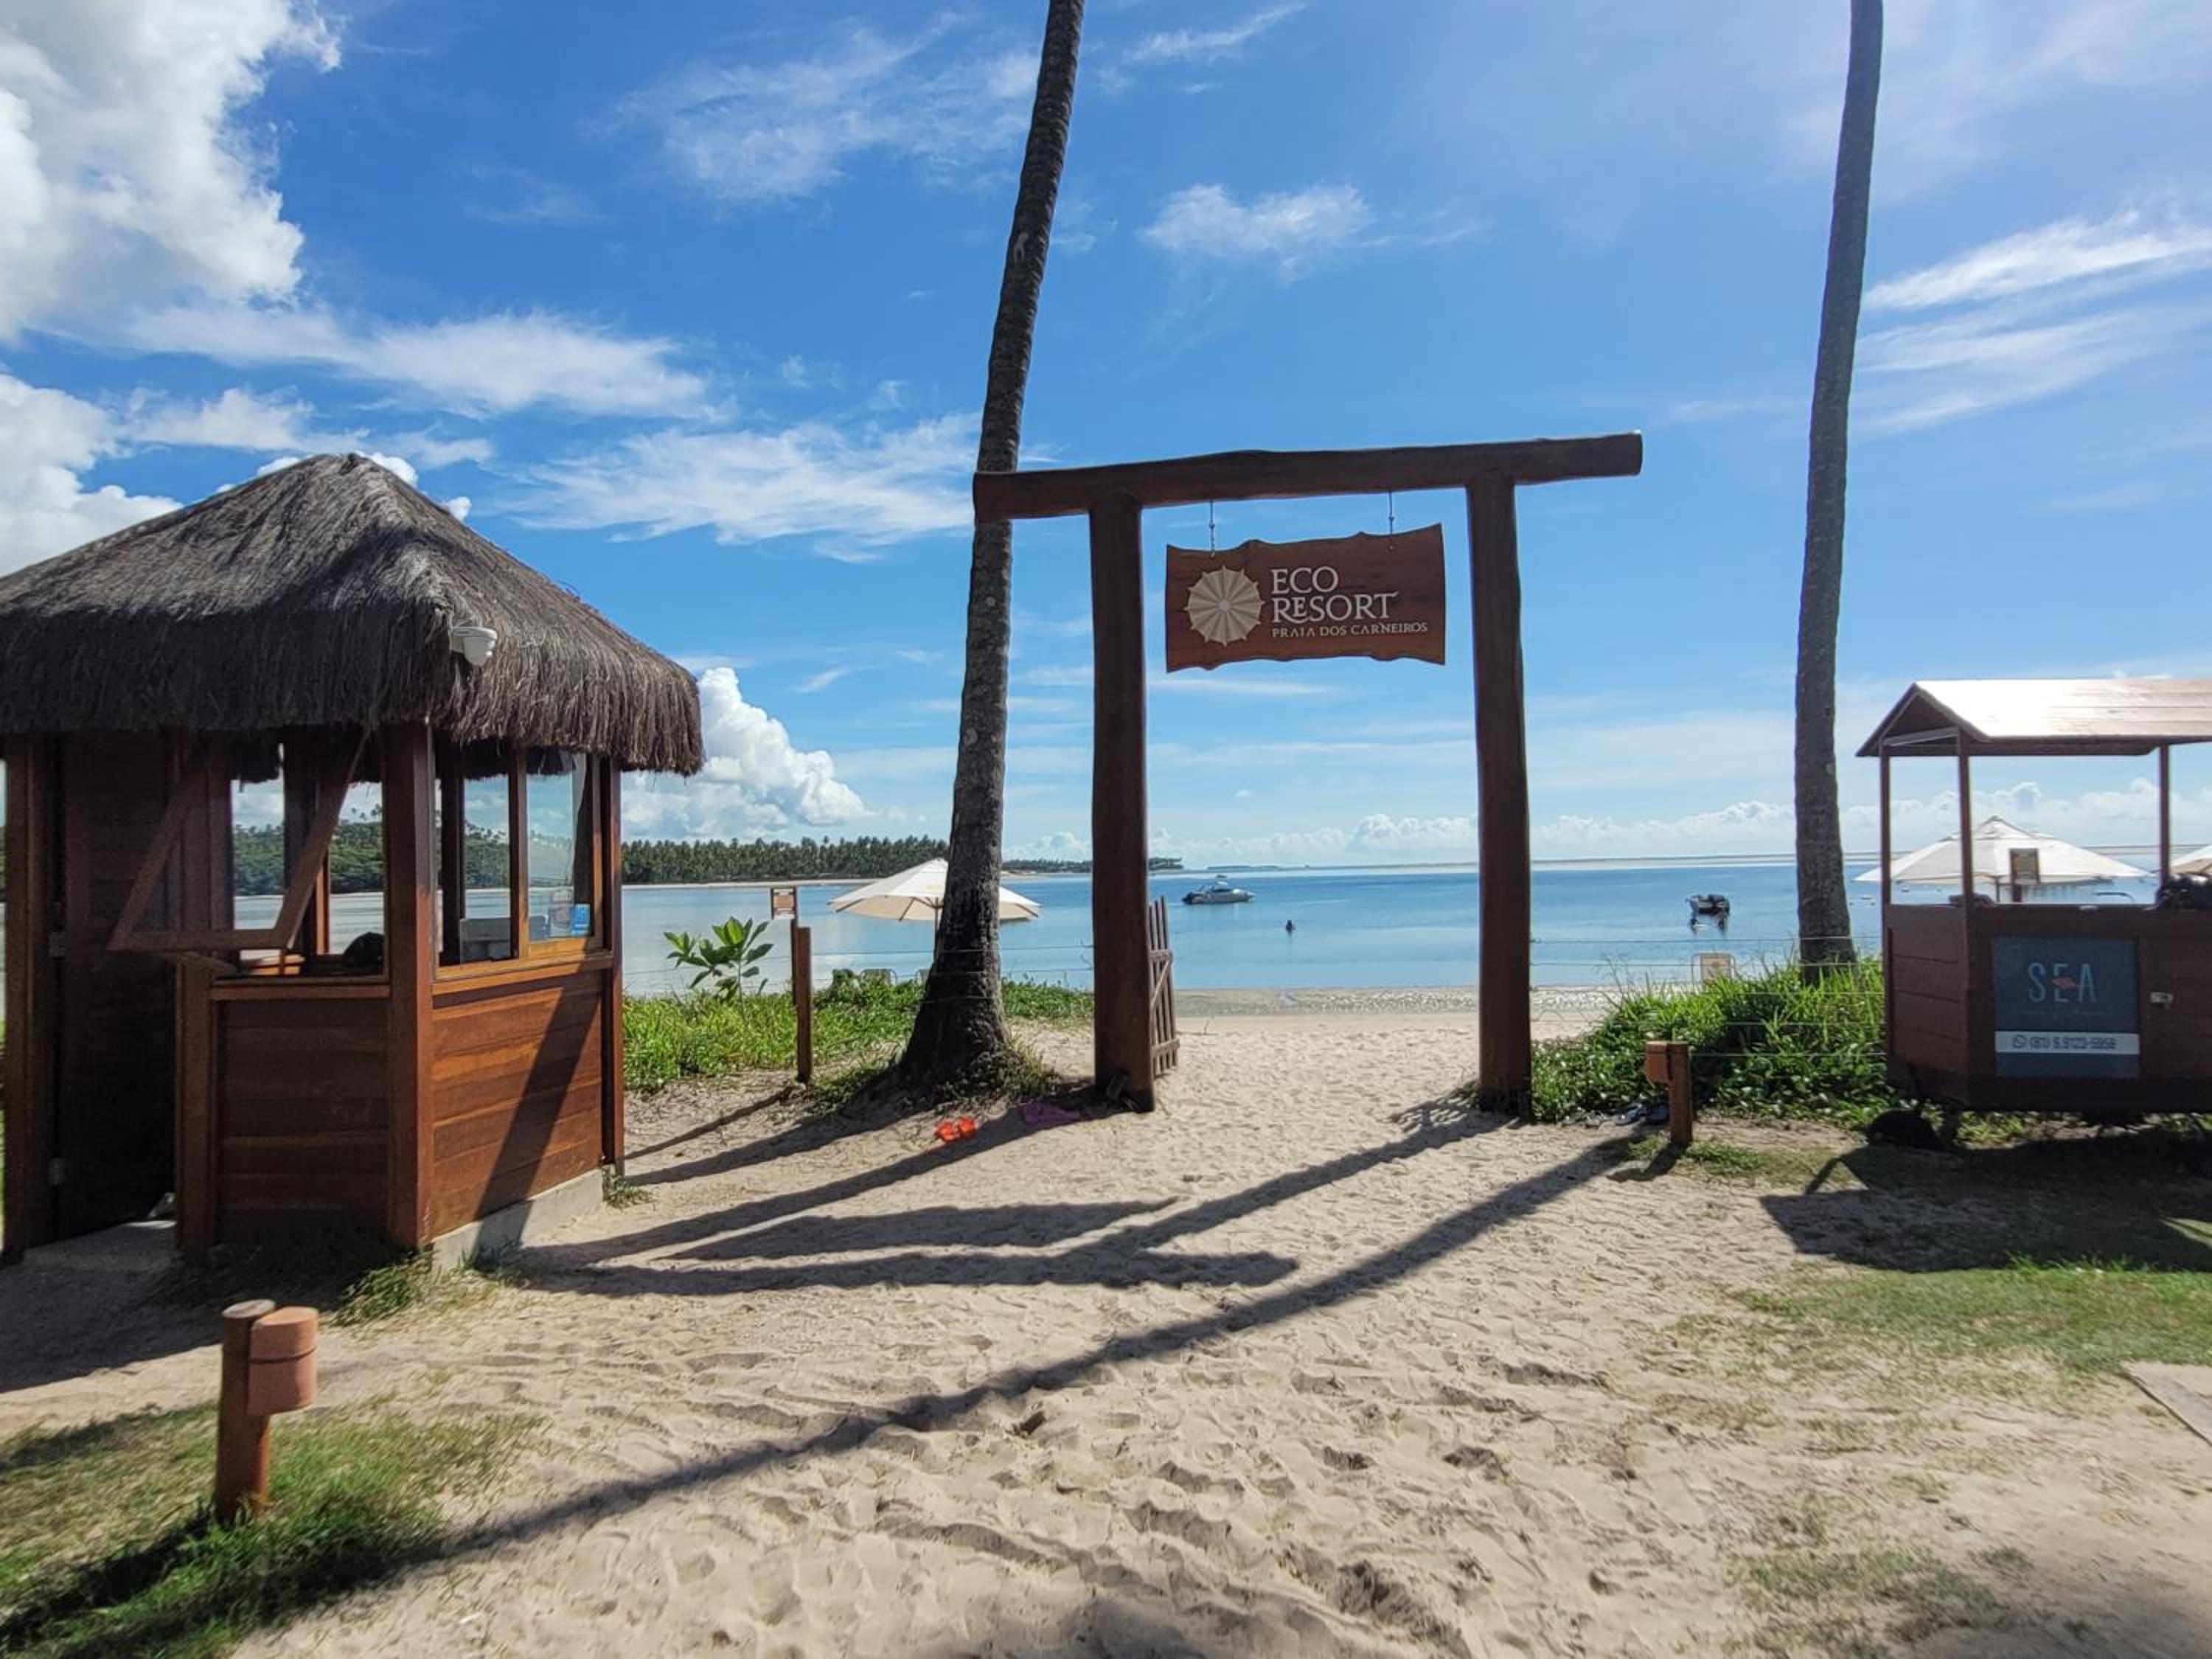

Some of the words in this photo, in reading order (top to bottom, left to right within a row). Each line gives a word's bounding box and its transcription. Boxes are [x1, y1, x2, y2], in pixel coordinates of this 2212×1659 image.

[1271, 566, 1339, 594] ECO
[1271, 591, 1399, 624] RESORT
[1272, 627, 1315, 638] PRAIA
[1320, 625, 1347, 637] DOS
[1352, 622, 1428, 636] CARNEIROS
[2028, 961, 2096, 1003] SEA
